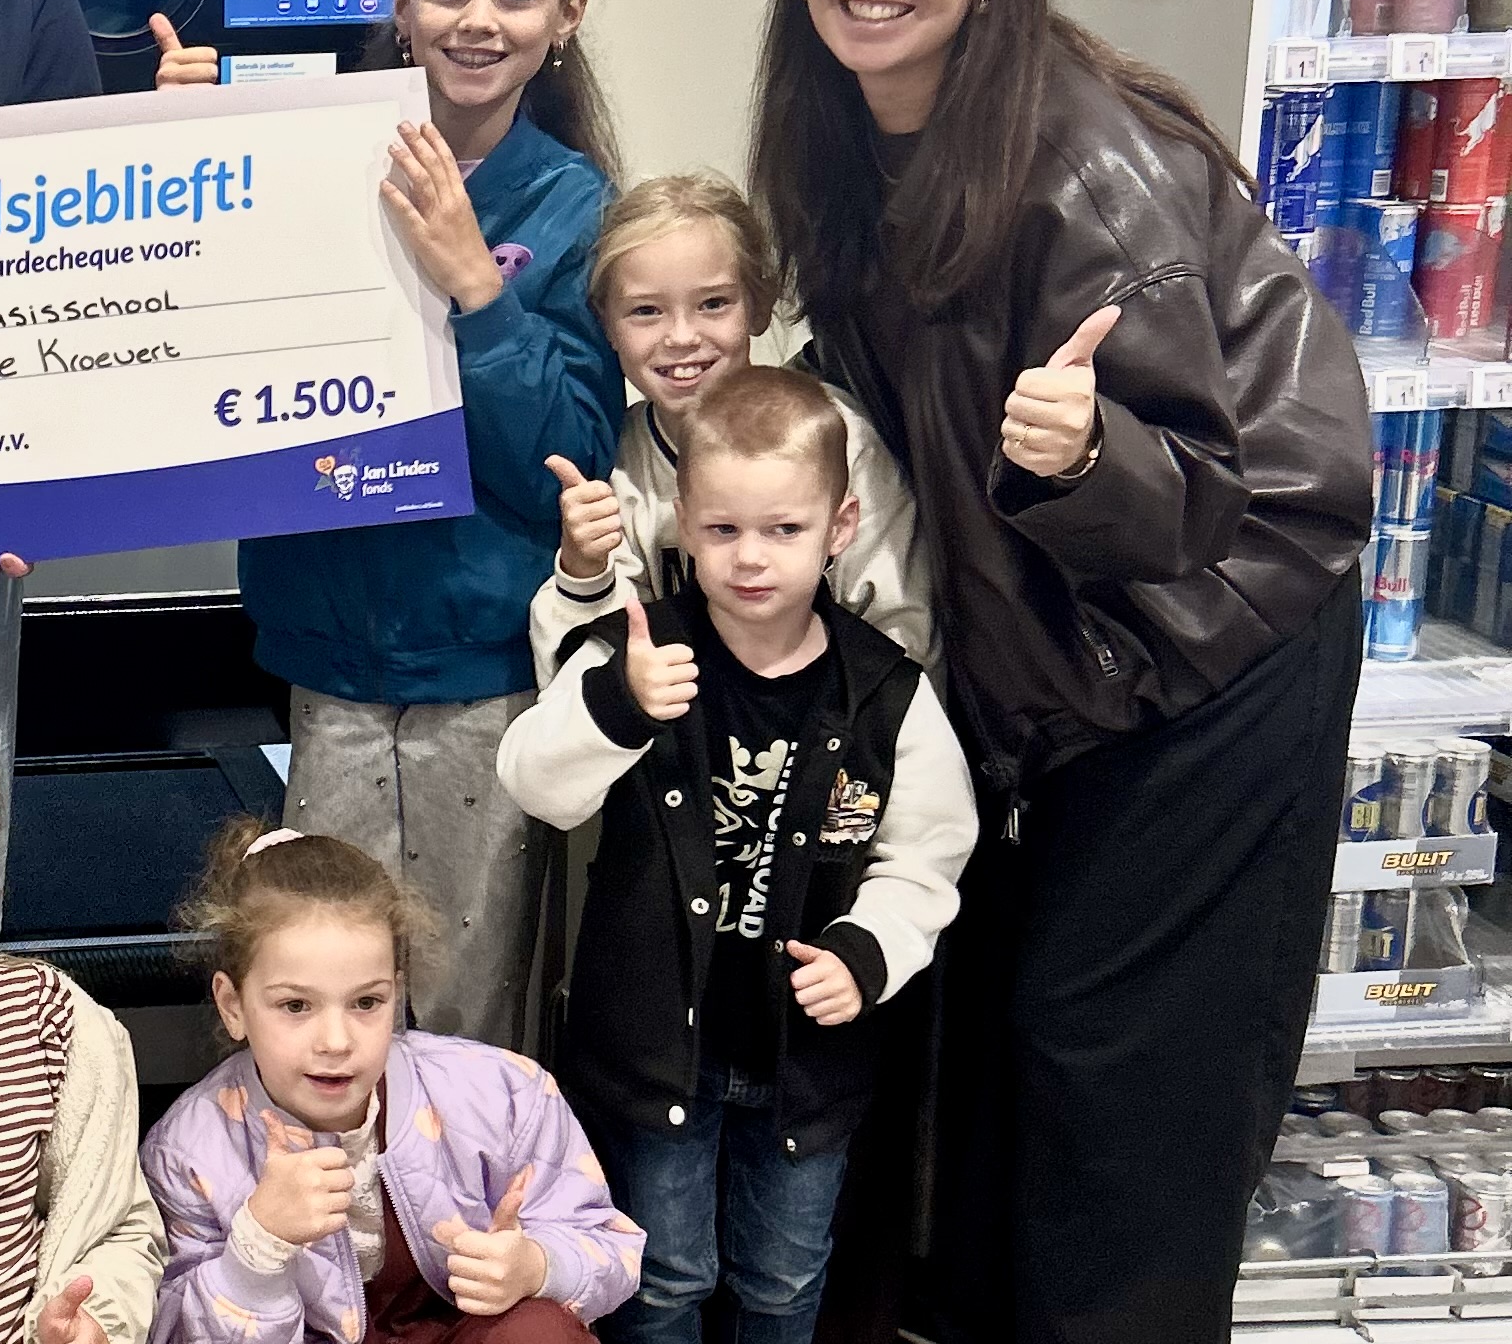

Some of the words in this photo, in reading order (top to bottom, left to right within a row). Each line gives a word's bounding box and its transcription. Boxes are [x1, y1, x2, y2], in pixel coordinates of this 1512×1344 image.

[139, 239, 201, 262] voor:
[37, 337, 181, 375] Kroevert
[214, 389, 242, 427] €
[255, 374, 395, 424] 1.500,-
[361, 465, 386, 481] Jan
[388, 460, 440, 479] Linders
[361, 481, 393, 497] fonds
